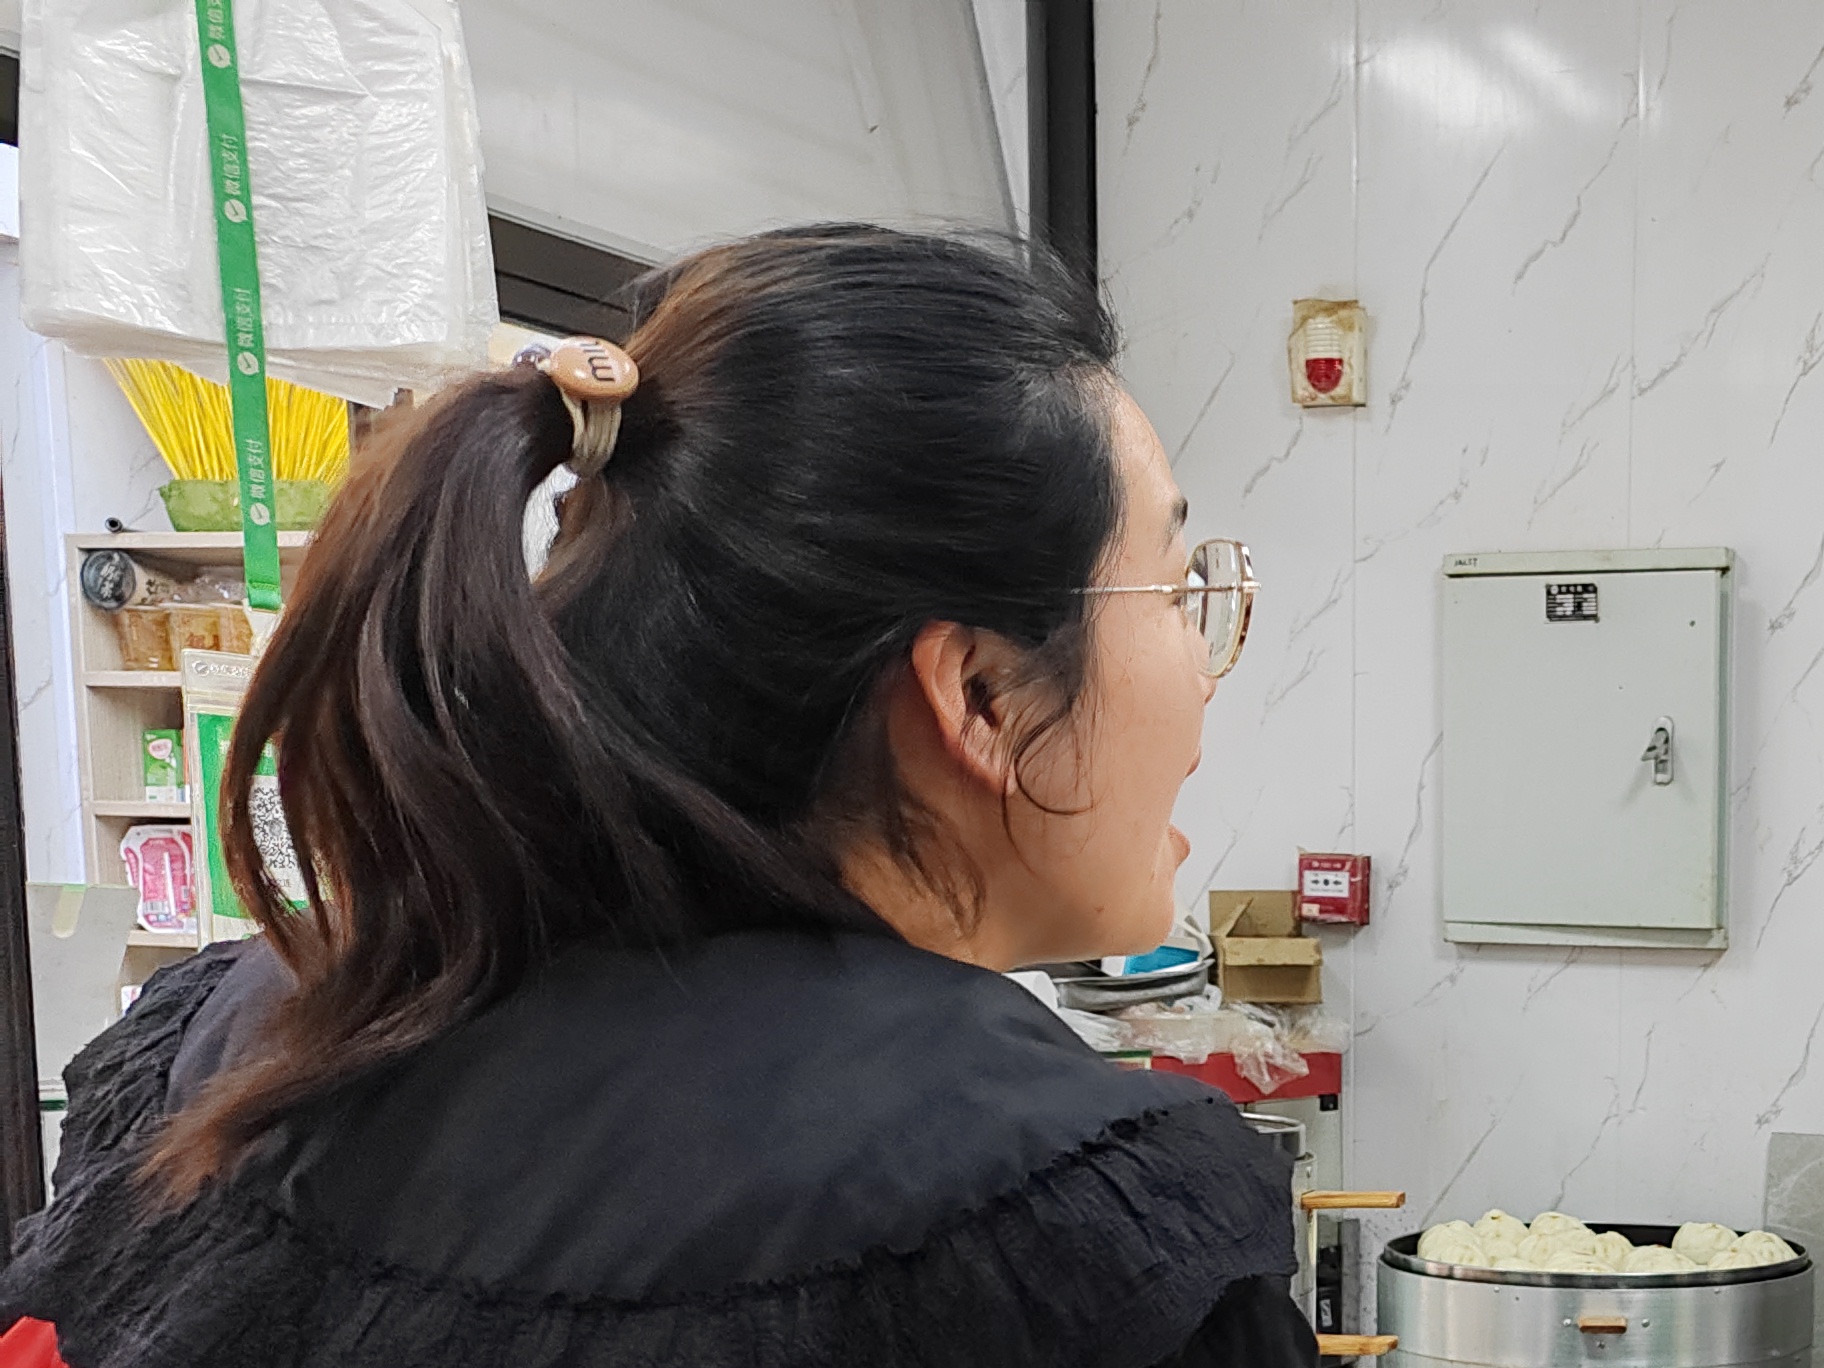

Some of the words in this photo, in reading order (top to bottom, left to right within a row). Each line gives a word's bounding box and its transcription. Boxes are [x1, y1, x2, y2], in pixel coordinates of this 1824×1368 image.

[221, 133, 241, 195] 微信支付
[233, 287, 254, 347] 微信支付
[245, 439, 265, 499] 微信支付
